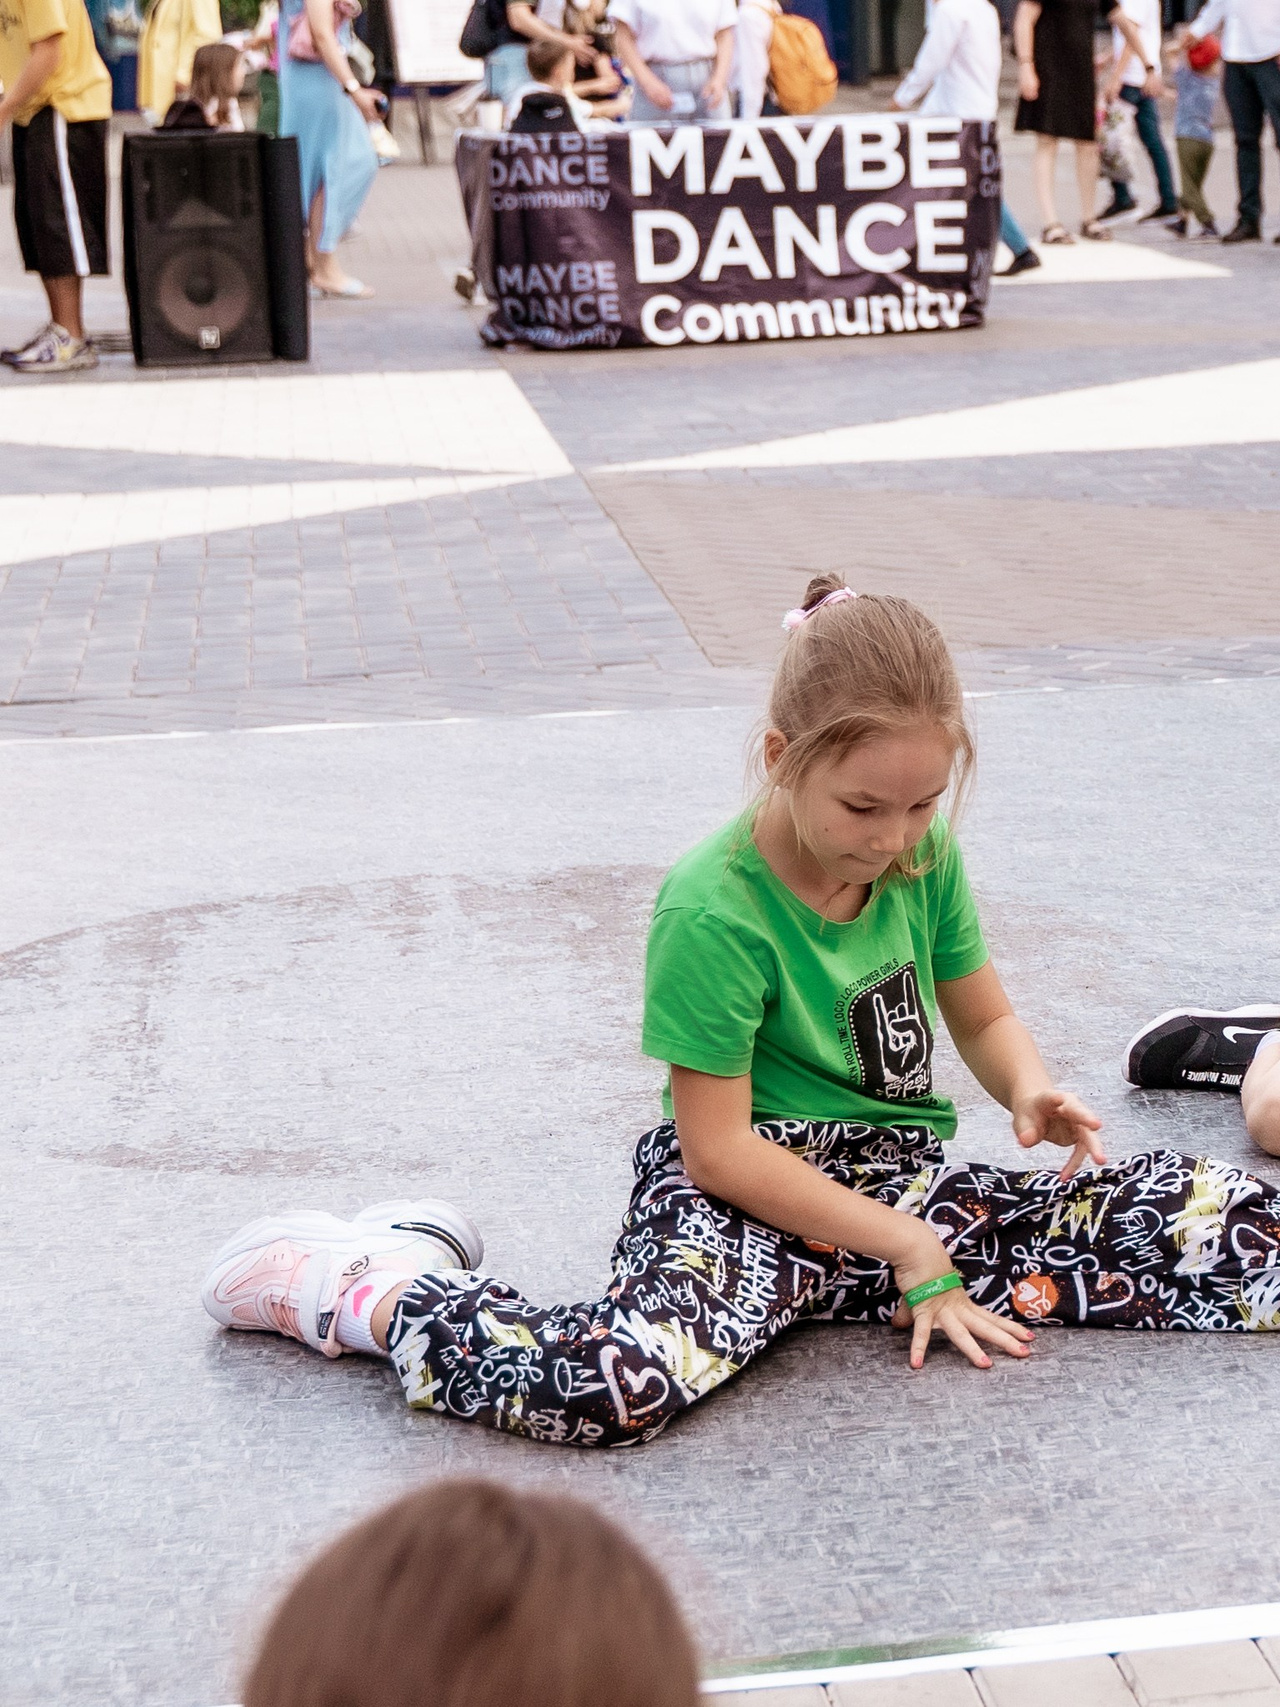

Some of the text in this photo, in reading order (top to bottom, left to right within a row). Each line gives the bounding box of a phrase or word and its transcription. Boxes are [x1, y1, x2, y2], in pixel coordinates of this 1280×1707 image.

[629, 117, 968, 197] MAYBE
[489, 154, 610, 188] DANCE
[491, 187, 611, 211] Community
[632, 203, 969, 284] DANCE
[496, 260, 619, 295] MAYBE
[501, 292, 622, 326] DANCE
[640, 281, 968, 346] Community
[879, 957, 900, 976] GIRLS
[856, 969, 883, 989] POWER
[833, 1000, 846, 1024] LOCO
[837, 1025, 849, 1044] TIME
[842, 1044, 855, 1066] ROLL
[1219, 1072, 1243, 1086] NIKE
